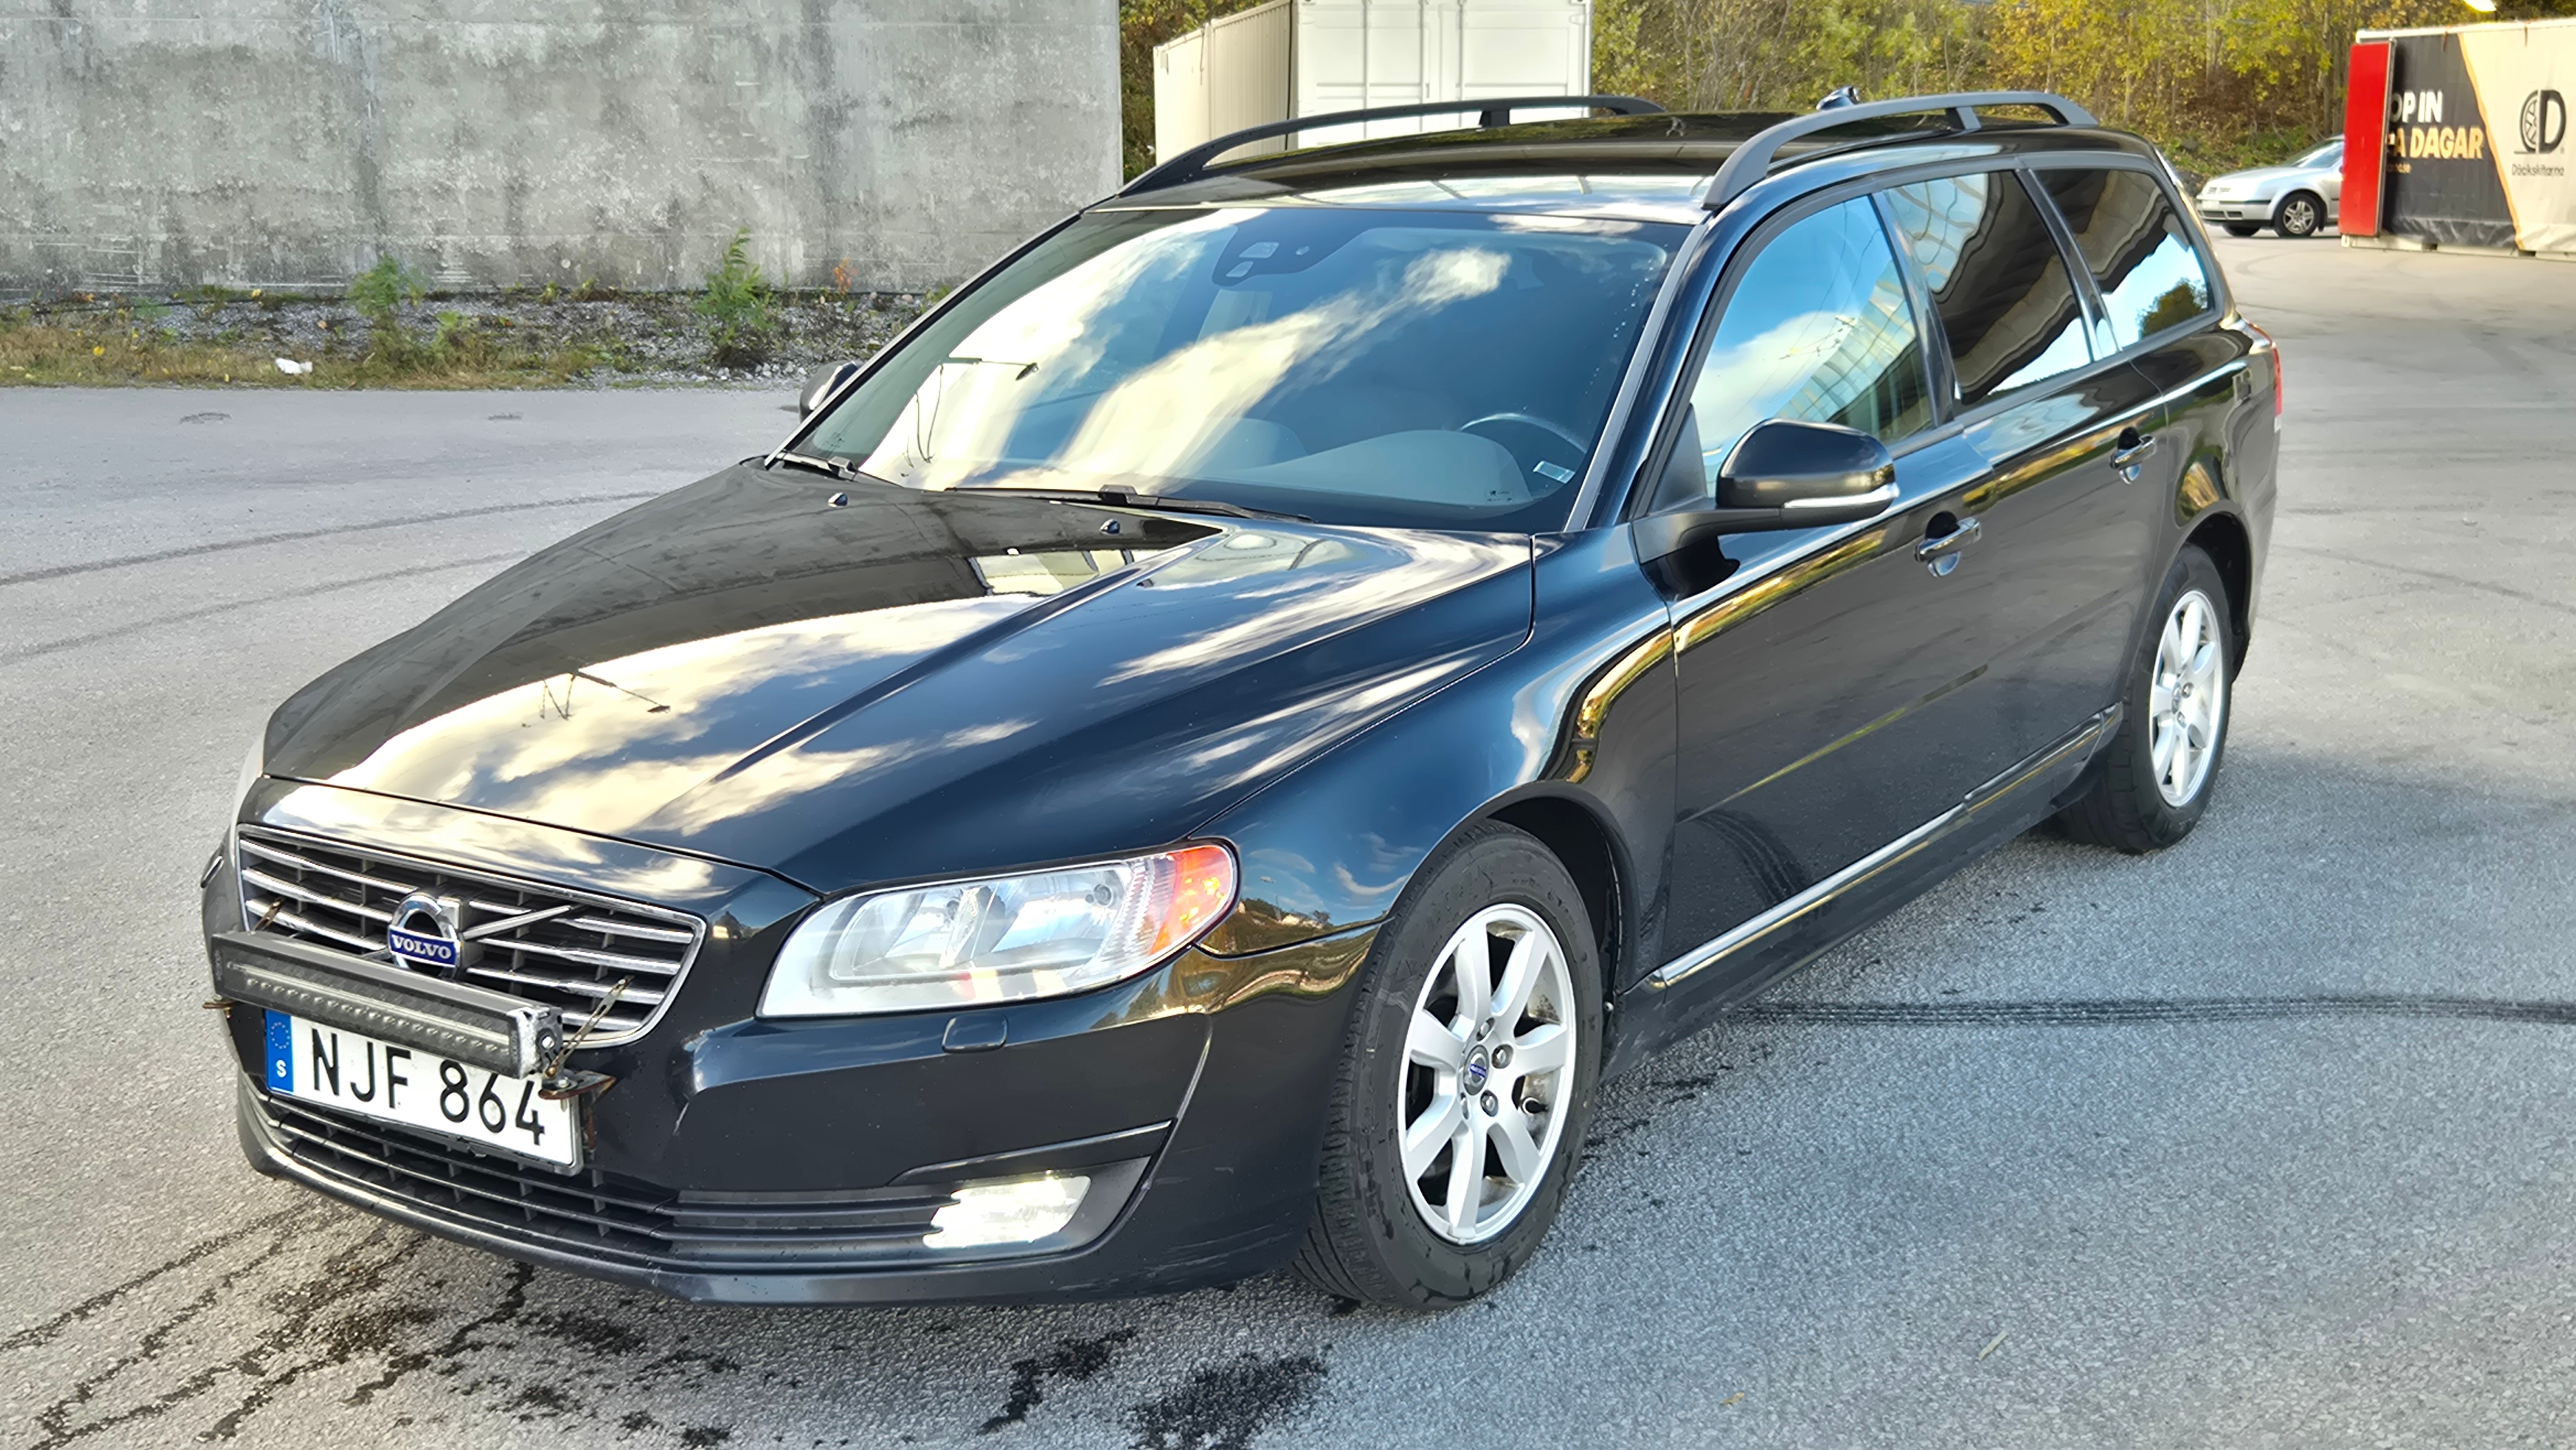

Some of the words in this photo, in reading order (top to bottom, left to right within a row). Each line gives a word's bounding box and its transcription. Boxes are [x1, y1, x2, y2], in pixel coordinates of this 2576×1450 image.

[2390, 89, 2416, 123] OP
[2418, 89, 2443, 123] IN
[2410, 127, 2484, 159] DAGAR
[392, 934, 451, 959] VOLVO
[276, 1060, 287, 1078] S
[312, 1028, 412, 1109] NJF
[440, 1059, 545, 1145] 864
